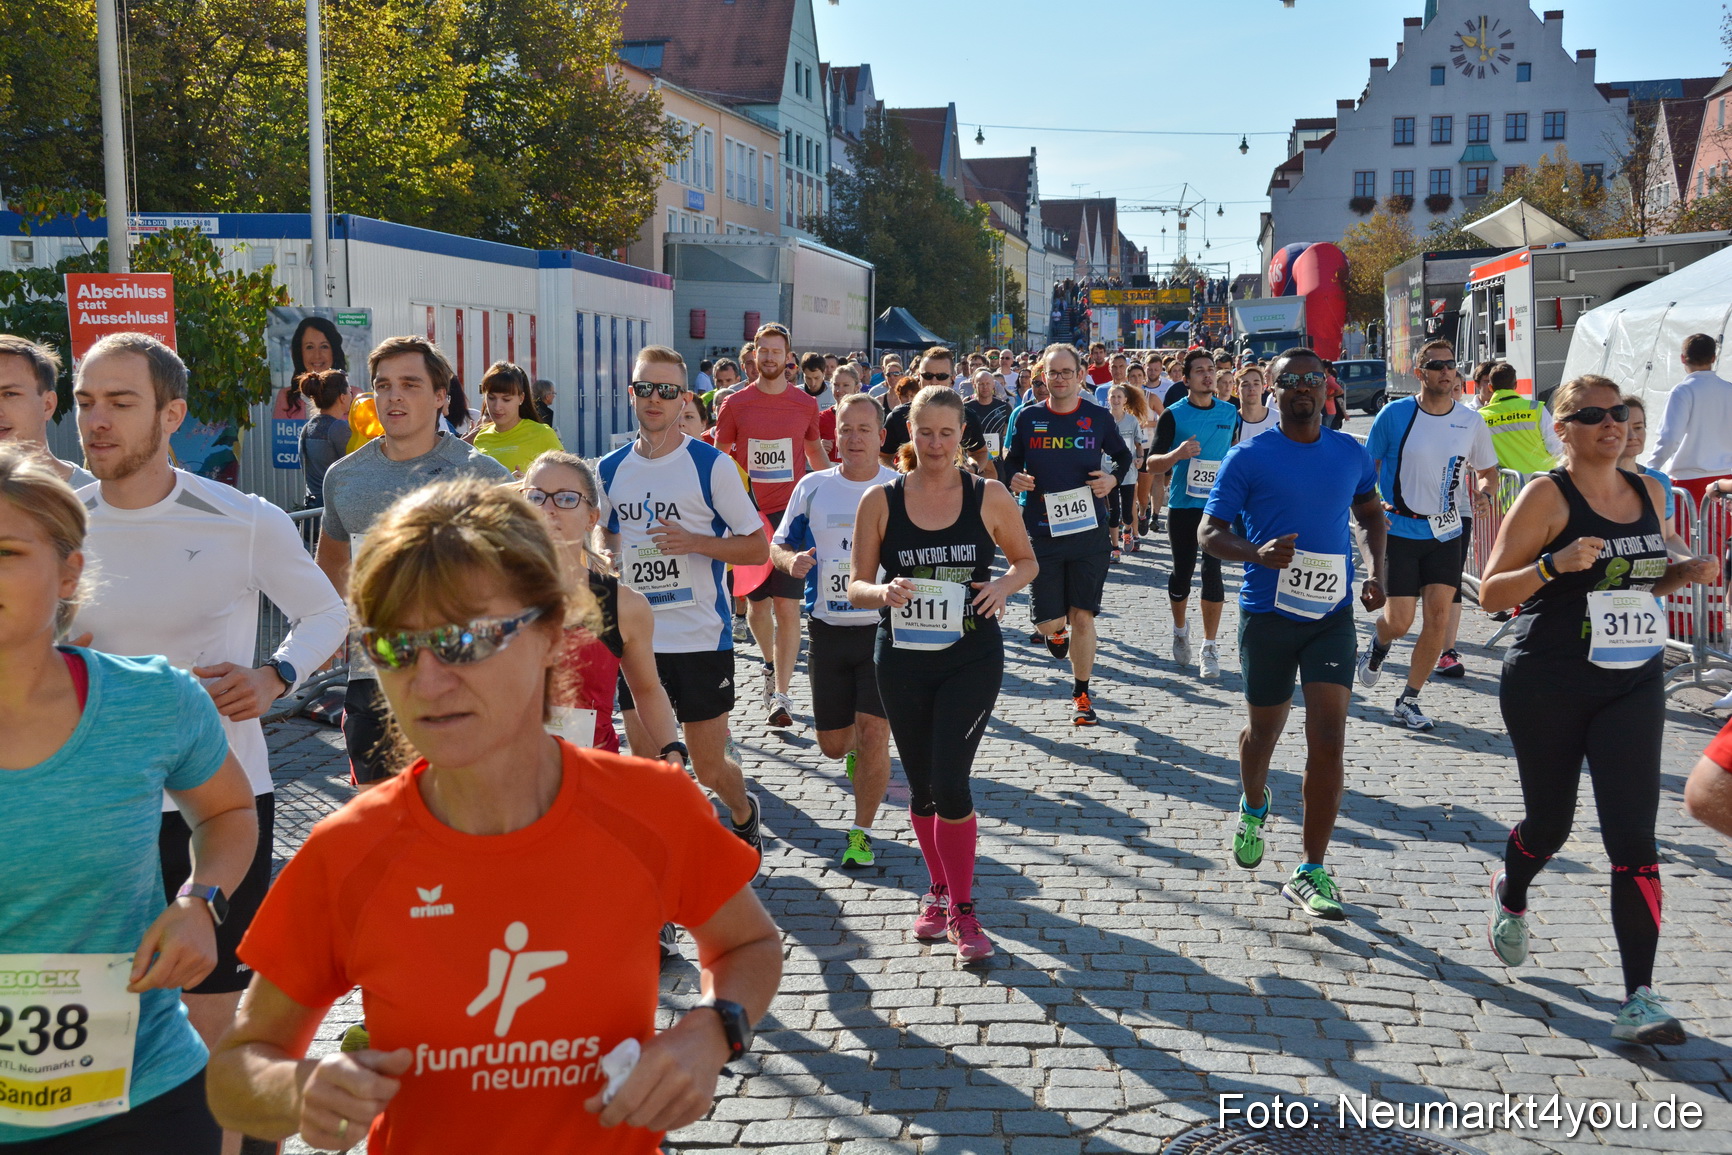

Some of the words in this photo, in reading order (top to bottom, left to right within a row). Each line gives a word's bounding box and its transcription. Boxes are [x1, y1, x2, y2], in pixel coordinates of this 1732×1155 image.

[77, 283, 167, 299] Abschluss
[1122, 292, 1158, 301] START
[77, 300, 107, 310] statt
[79, 310, 169, 325] Ausschluss!
[1485, 412, 1532, 426] g.-Leiter
[277, 422, 303, 439] Helg
[1029, 437, 1095, 449] MENSCH
[277, 453, 300, 464] CSU
[754, 450, 786, 465] 3004
[1193, 470, 1218, 482] 235
[1054, 499, 1087, 518] 3146
[638, 548, 661, 556] BOC
[898, 550, 915, 567] ICH
[916, 546, 948, 565] WERDE
[950, 544, 976, 562] NICHT
[1596, 539, 1613, 559] CH
[1612, 536, 1646, 556] WERDE
[1303, 557, 1332, 568] BOCK
[632, 559, 680, 583] 2394
[831, 574, 850, 593] 30
[1289, 568, 1338, 593] 3122
[648, 592, 676, 604] ominik
[901, 598, 948, 620] 3111
[1604, 612, 1656, 636] 3112
[410, 903, 454, 919] erima
[0, 970, 81, 988] BOCK
[415, 1036, 600, 1076] funrunners
[20, 1059, 76, 1074] Neumarkt
